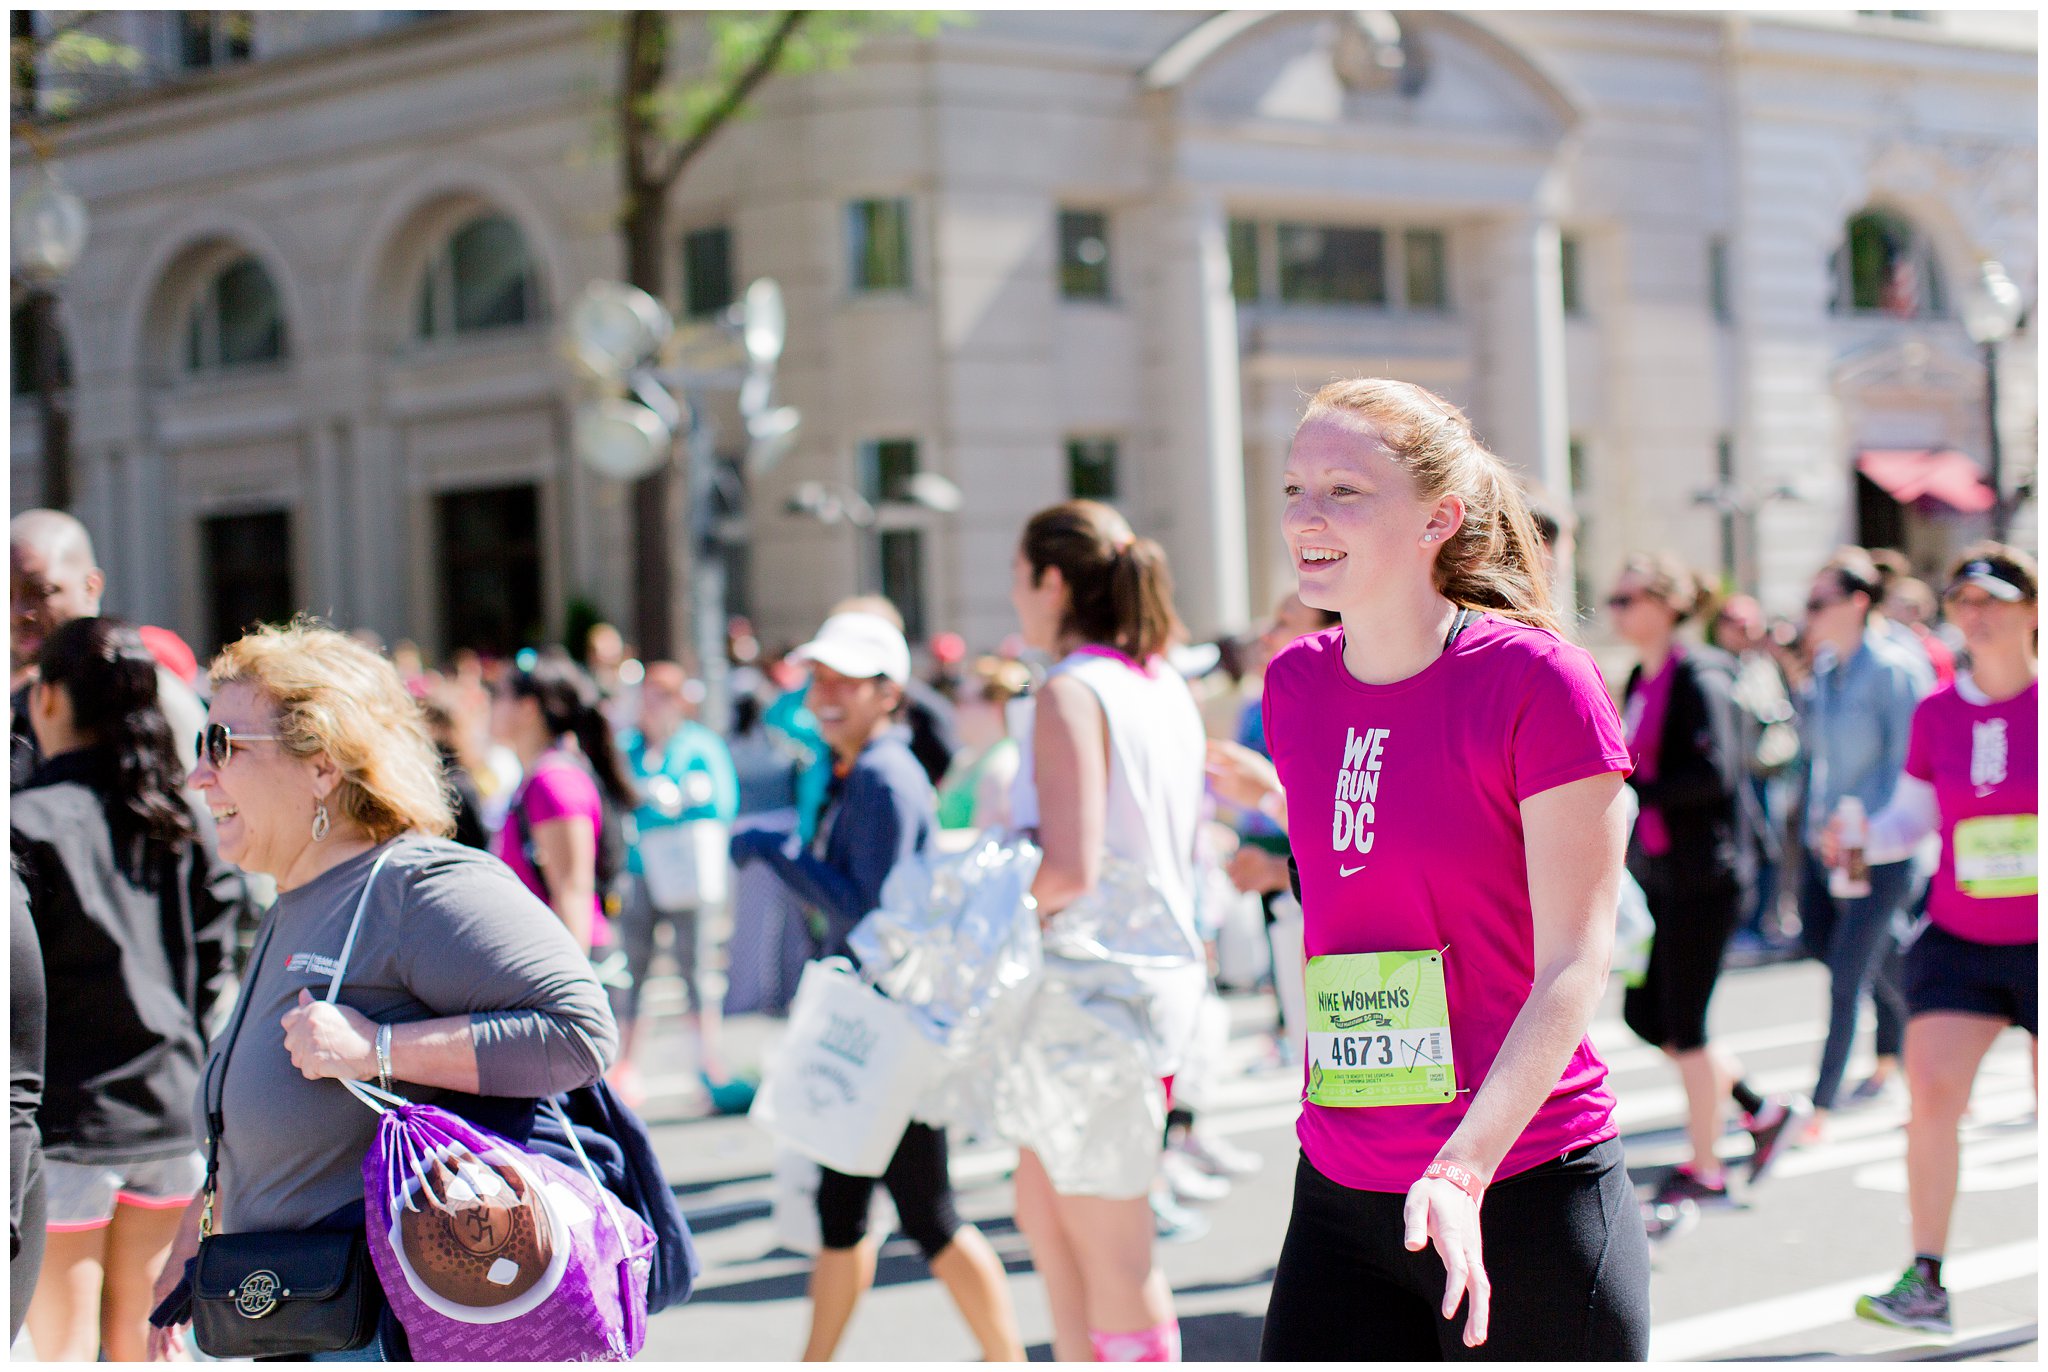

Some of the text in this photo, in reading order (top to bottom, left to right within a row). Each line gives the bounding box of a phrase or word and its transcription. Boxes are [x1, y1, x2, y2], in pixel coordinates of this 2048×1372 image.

[1342, 727, 1390, 771] WE
[1335, 769, 1380, 802] RUN
[1332, 800, 1375, 854] DC
[1318, 986, 1410, 1012] NIKE WOMEN'S
[1332, 1035, 1393, 1066] 4673
